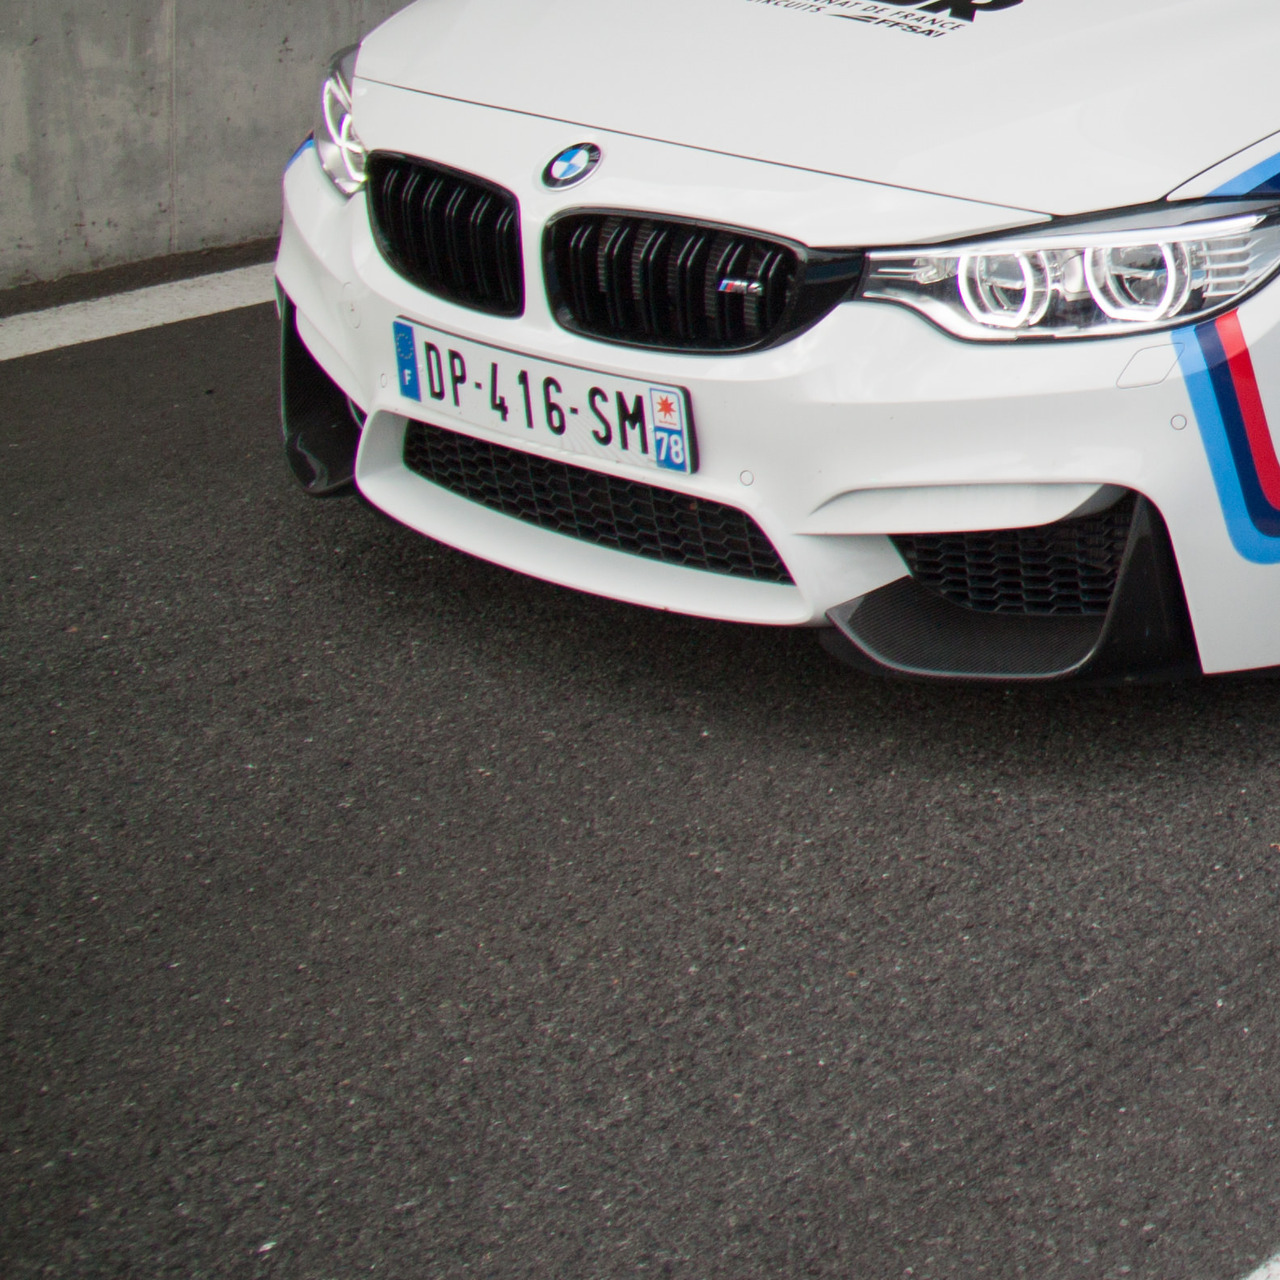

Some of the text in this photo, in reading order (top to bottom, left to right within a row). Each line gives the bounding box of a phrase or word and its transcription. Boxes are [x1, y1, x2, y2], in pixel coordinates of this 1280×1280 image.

[861, 3, 890, 15] DE
[888, 10, 967, 32] FRANCE
[402, 368, 412, 386] F
[424, 340, 649, 455] DP-416-SM
[655, 430, 685, 465] 78
